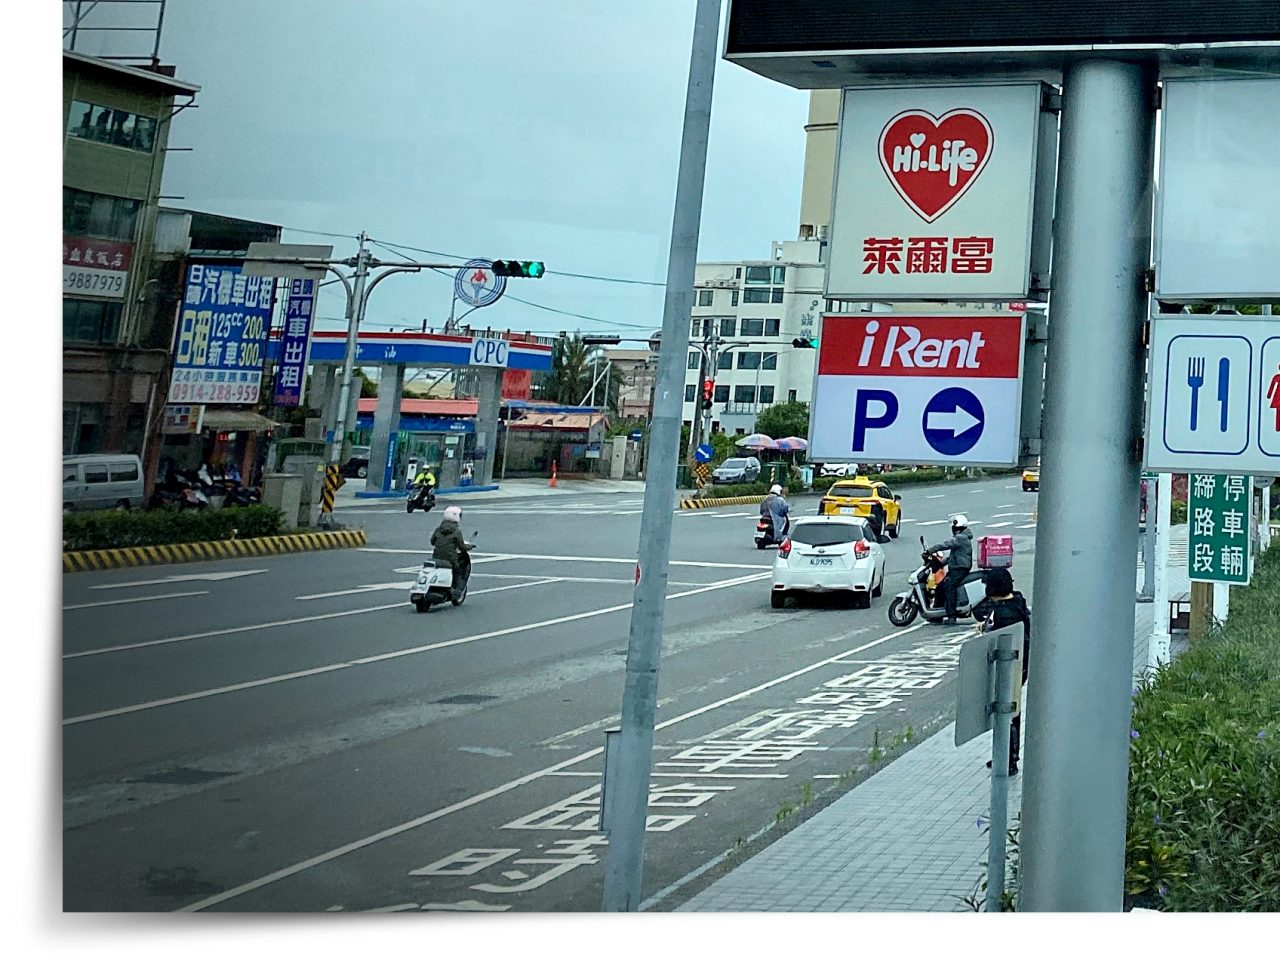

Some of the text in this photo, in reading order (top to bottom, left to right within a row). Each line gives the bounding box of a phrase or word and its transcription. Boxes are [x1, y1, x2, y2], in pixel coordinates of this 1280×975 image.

[862, 236, 995, 275] 萊爾富
[473, 338, 507, 365] CPC
[852, 389, 899, 452] P
